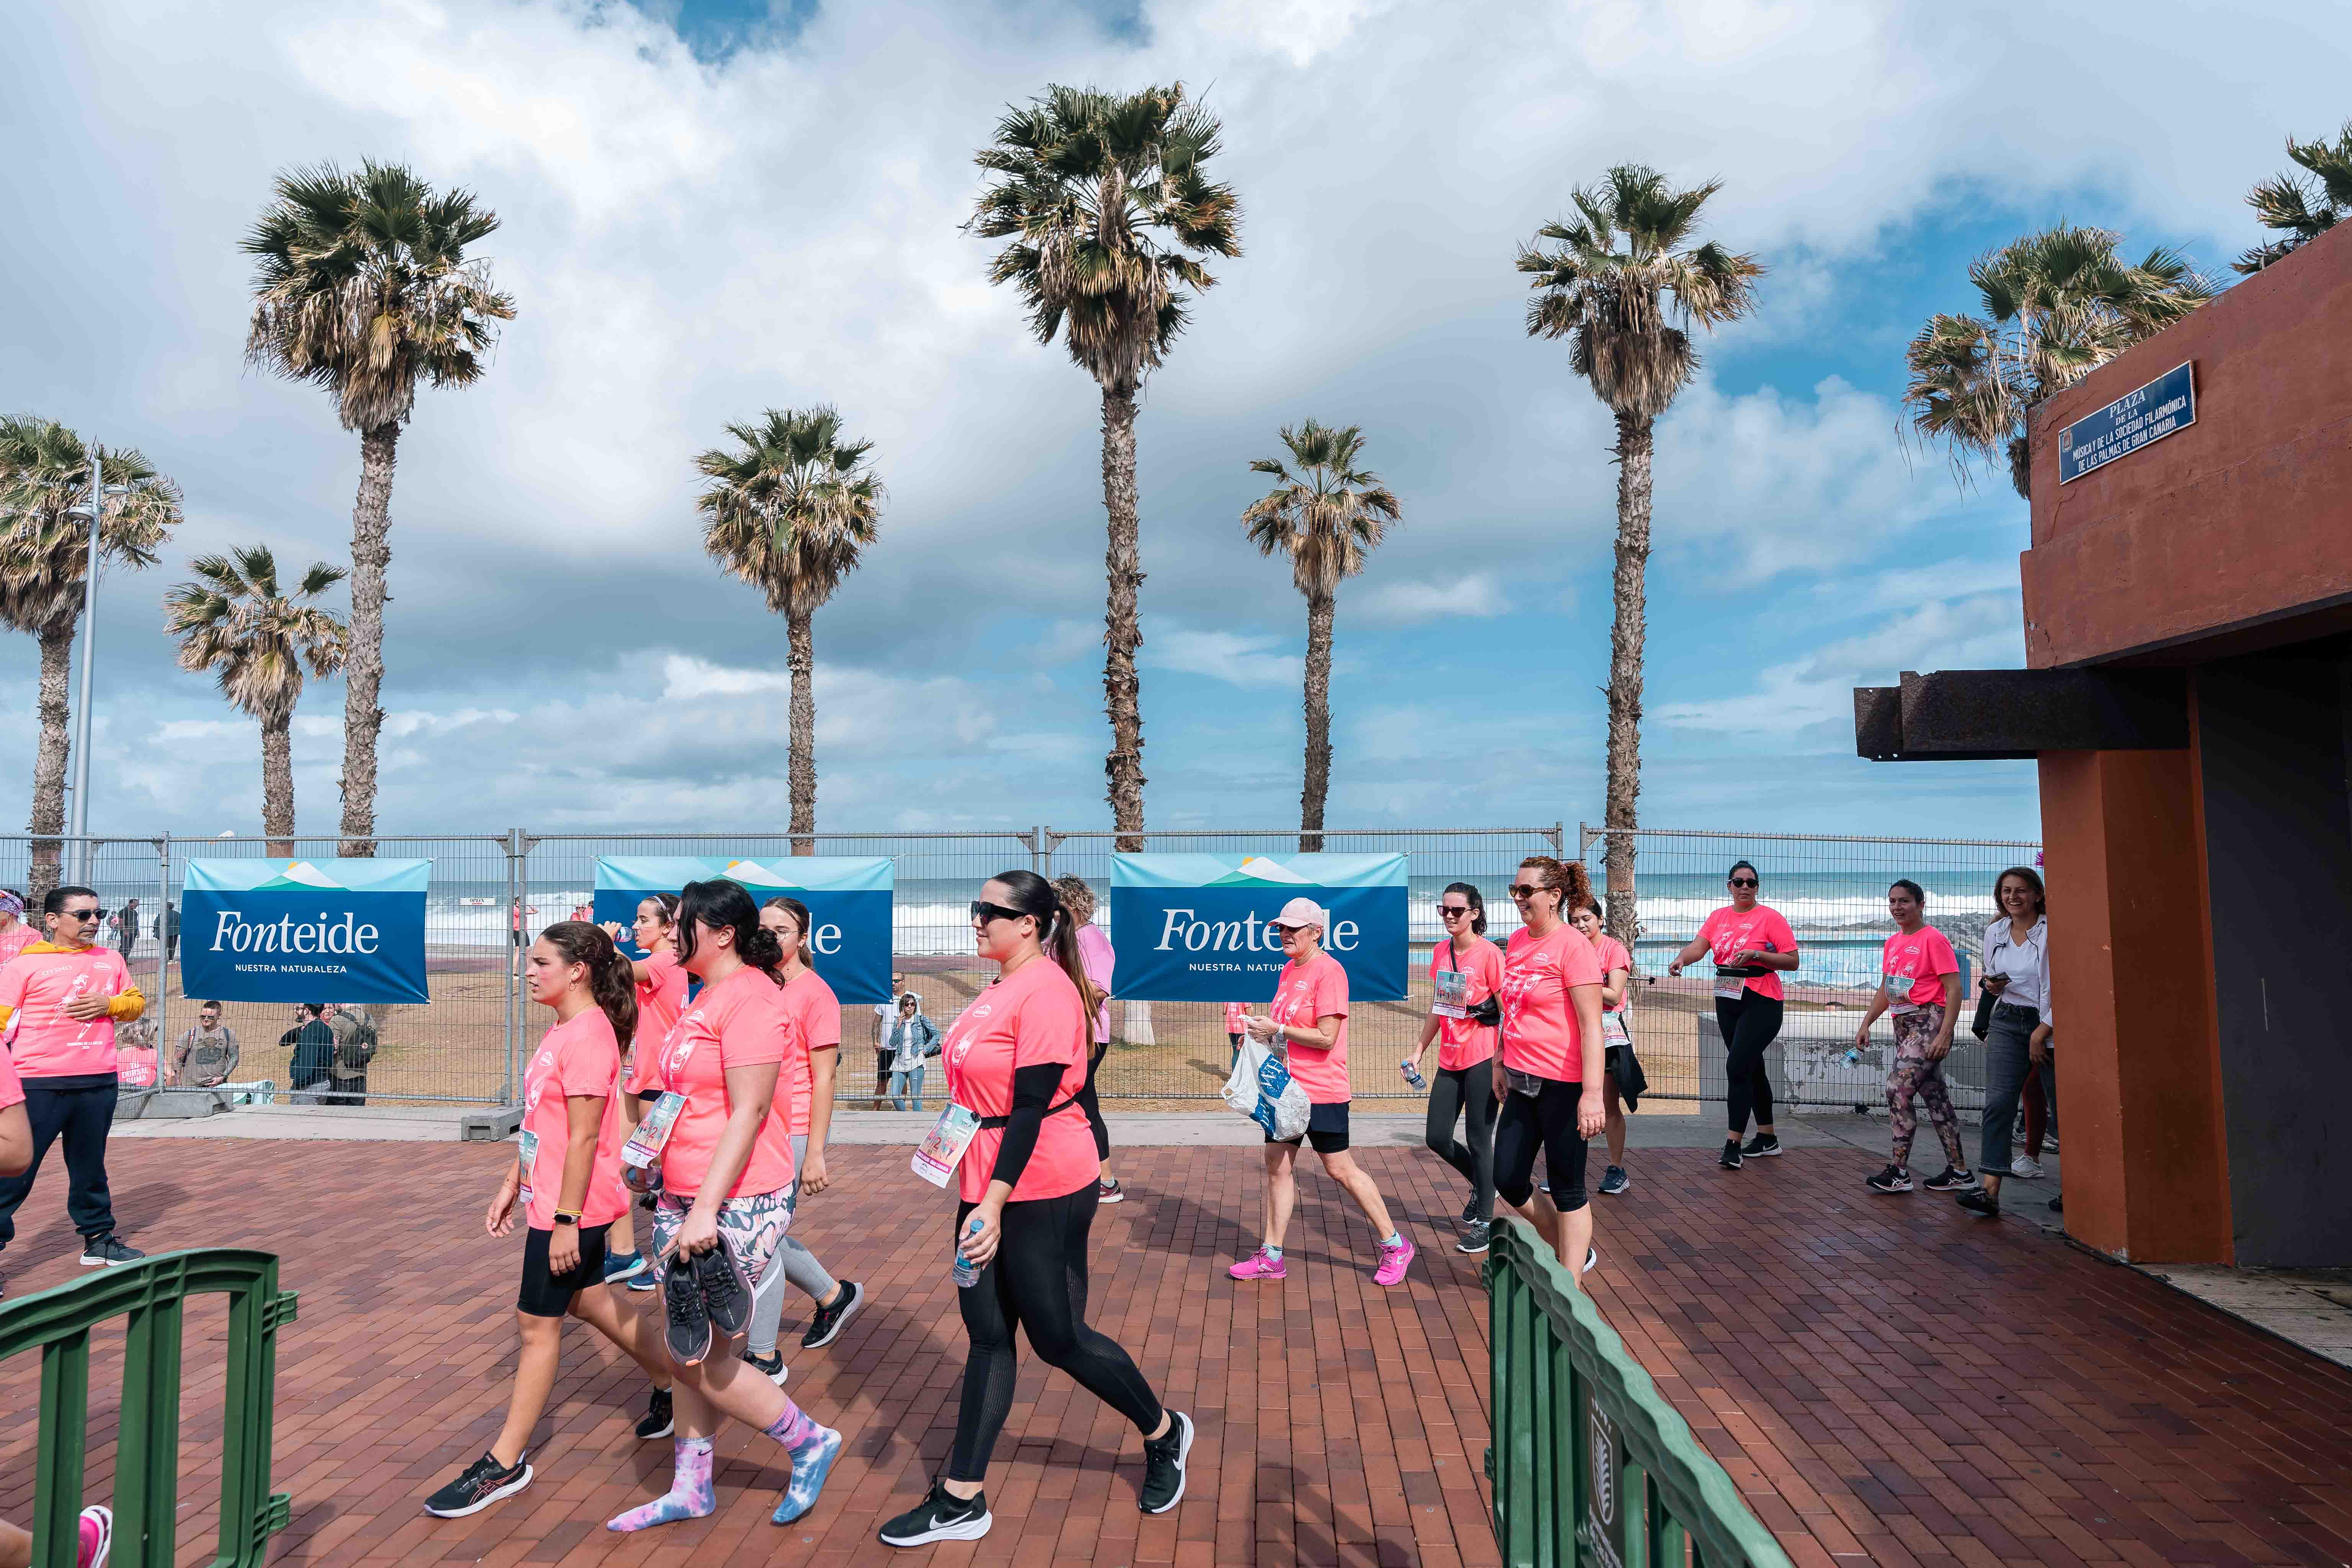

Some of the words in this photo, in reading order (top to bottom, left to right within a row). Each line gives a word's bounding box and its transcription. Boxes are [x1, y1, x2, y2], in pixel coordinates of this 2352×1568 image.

[2110, 390, 2146, 419] PLAZA
[2115, 414, 2126, 426] DE
[2128, 408, 2138, 420] LA
[2073, 443, 2092, 461] MÚSICA
[2092, 440, 2096, 451] Y
[2097, 436, 2104, 449] DE
[2106, 431, 2114, 445] LA
[2115, 416, 2143, 440] SOCIEDAD
[2145, 395, 2186, 426] FILARMÓNICA
[2079, 459, 2085, 472] DE
[2087, 454, 2097, 468] LAS
[2099, 442, 2121, 462] PALMAS
[2123, 437, 2130, 451] DE
[2132, 429, 2148, 447] GRAN
[2149, 415, 2176, 438] CANARIA
[209, 911, 378, 953] Fonteide
[1154, 909, 1359, 951] Fontede
[235, 964, 276, 972] NUESTRA
